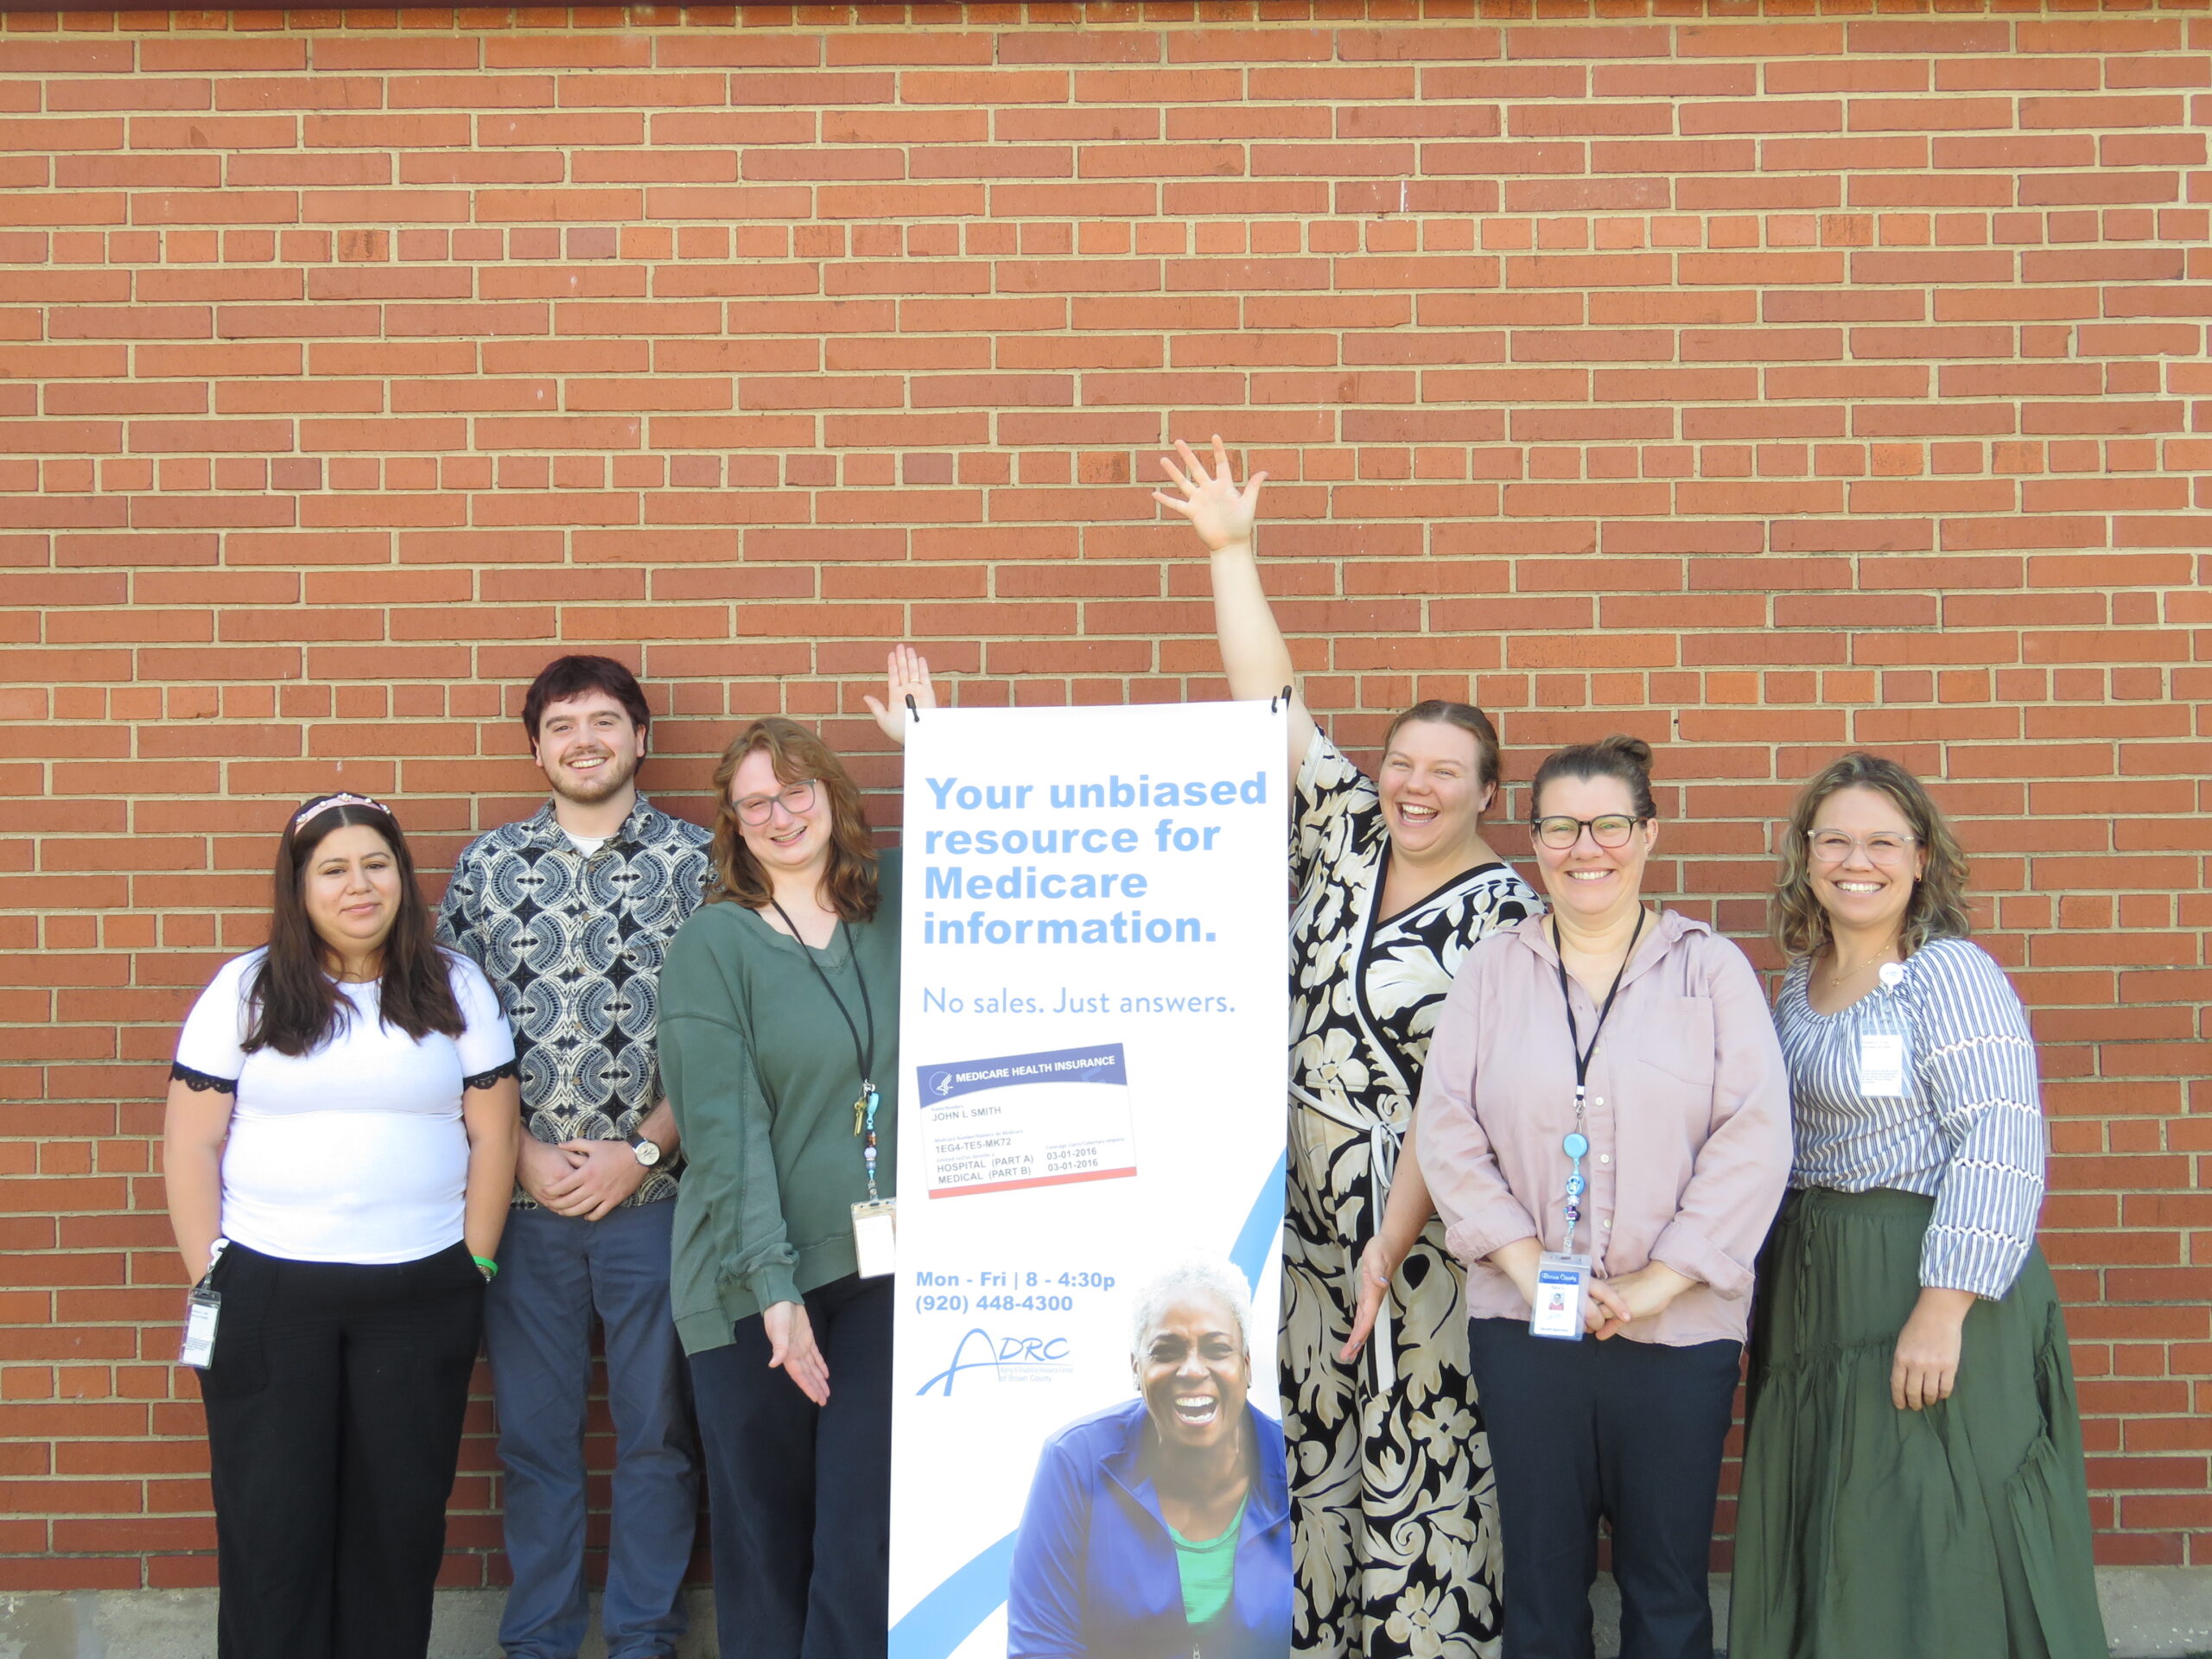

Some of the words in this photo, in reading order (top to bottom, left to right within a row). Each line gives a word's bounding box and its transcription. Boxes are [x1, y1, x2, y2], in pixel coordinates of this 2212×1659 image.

[925, 777, 1033, 810] Your
[1050, 771, 1267, 808] unbiased
[925, 827, 1138, 855] resource
[1155, 818, 1221, 851] for
[925, 866, 1147, 899] Medicare
[924, 910, 1217, 944] information.
[923, 987, 963, 1013] No
[974, 987, 1045, 1014] sales.
[1052, 987, 1110, 1014] Just
[1120, 995, 1236, 1013] answers.
[956, 1068, 1009, 1084] MEDICARE
[1012, 1063, 1052, 1077] HEALTH
[1054, 1055, 1116, 1071] INSURANCE
[932, 1111, 960, 1122] JOHN
[962, 1109, 969, 1118] L
[970, 1107, 1001, 1117] SMITH
[935, 1138, 1012, 1154] 1EG4-TE5-MK72
[1046, 1147, 1097, 1160] 03-01-2016
[938, 1160, 986, 1173] HOSPITAL
[991, 1156, 1021, 1167] (PART
[1023, 1155, 1034, 1165] A)
[1048, 1159, 1098, 1172] 03-01-2016
[938, 1173, 983, 1184] MEDICAL
[988, 1168, 1019, 1180] (PART
[1021, 1166, 1032, 1176] B)
[916, 1271, 959, 1287] Mon
[980, 1271, 1006, 1287] Fri
[1026, 1272, 1038, 1287] 8
[1058, 1272, 1116, 1291] 4:30p
[916, 1295, 969, 1314] (920)
[976, 1295, 1073, 1311] 448-4300
[915, 1328, 1071, 1396] ADRC
[1029, 1375, 1052, 1383] County
